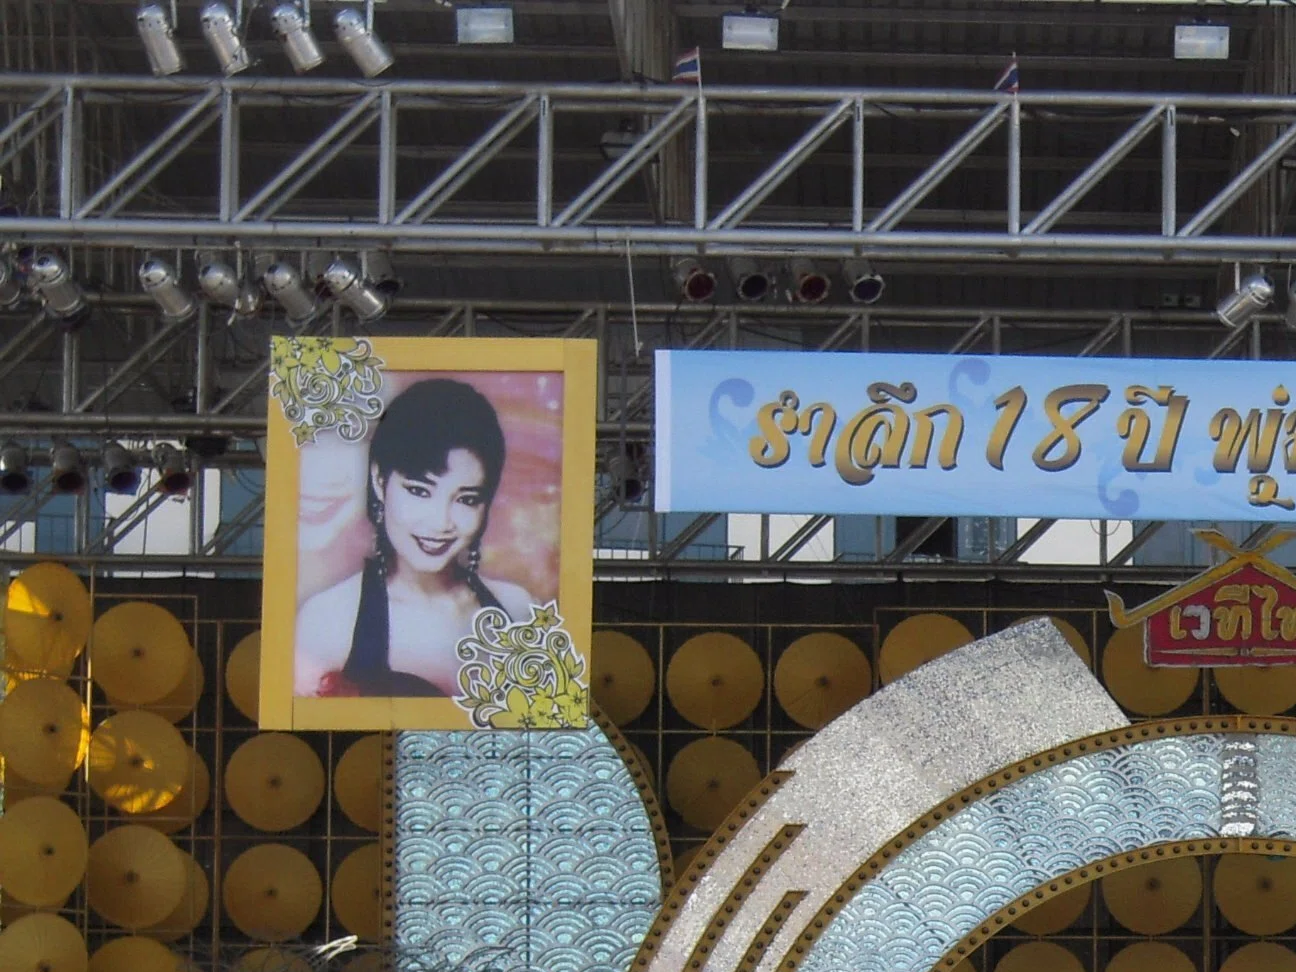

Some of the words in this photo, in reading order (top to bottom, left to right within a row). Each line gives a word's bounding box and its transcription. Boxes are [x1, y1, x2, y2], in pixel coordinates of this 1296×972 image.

[749, 381, 965, 486] รำลึก
[984, 383, 1110, 472] 18
[1116, 384, 1190, 473] ปี
